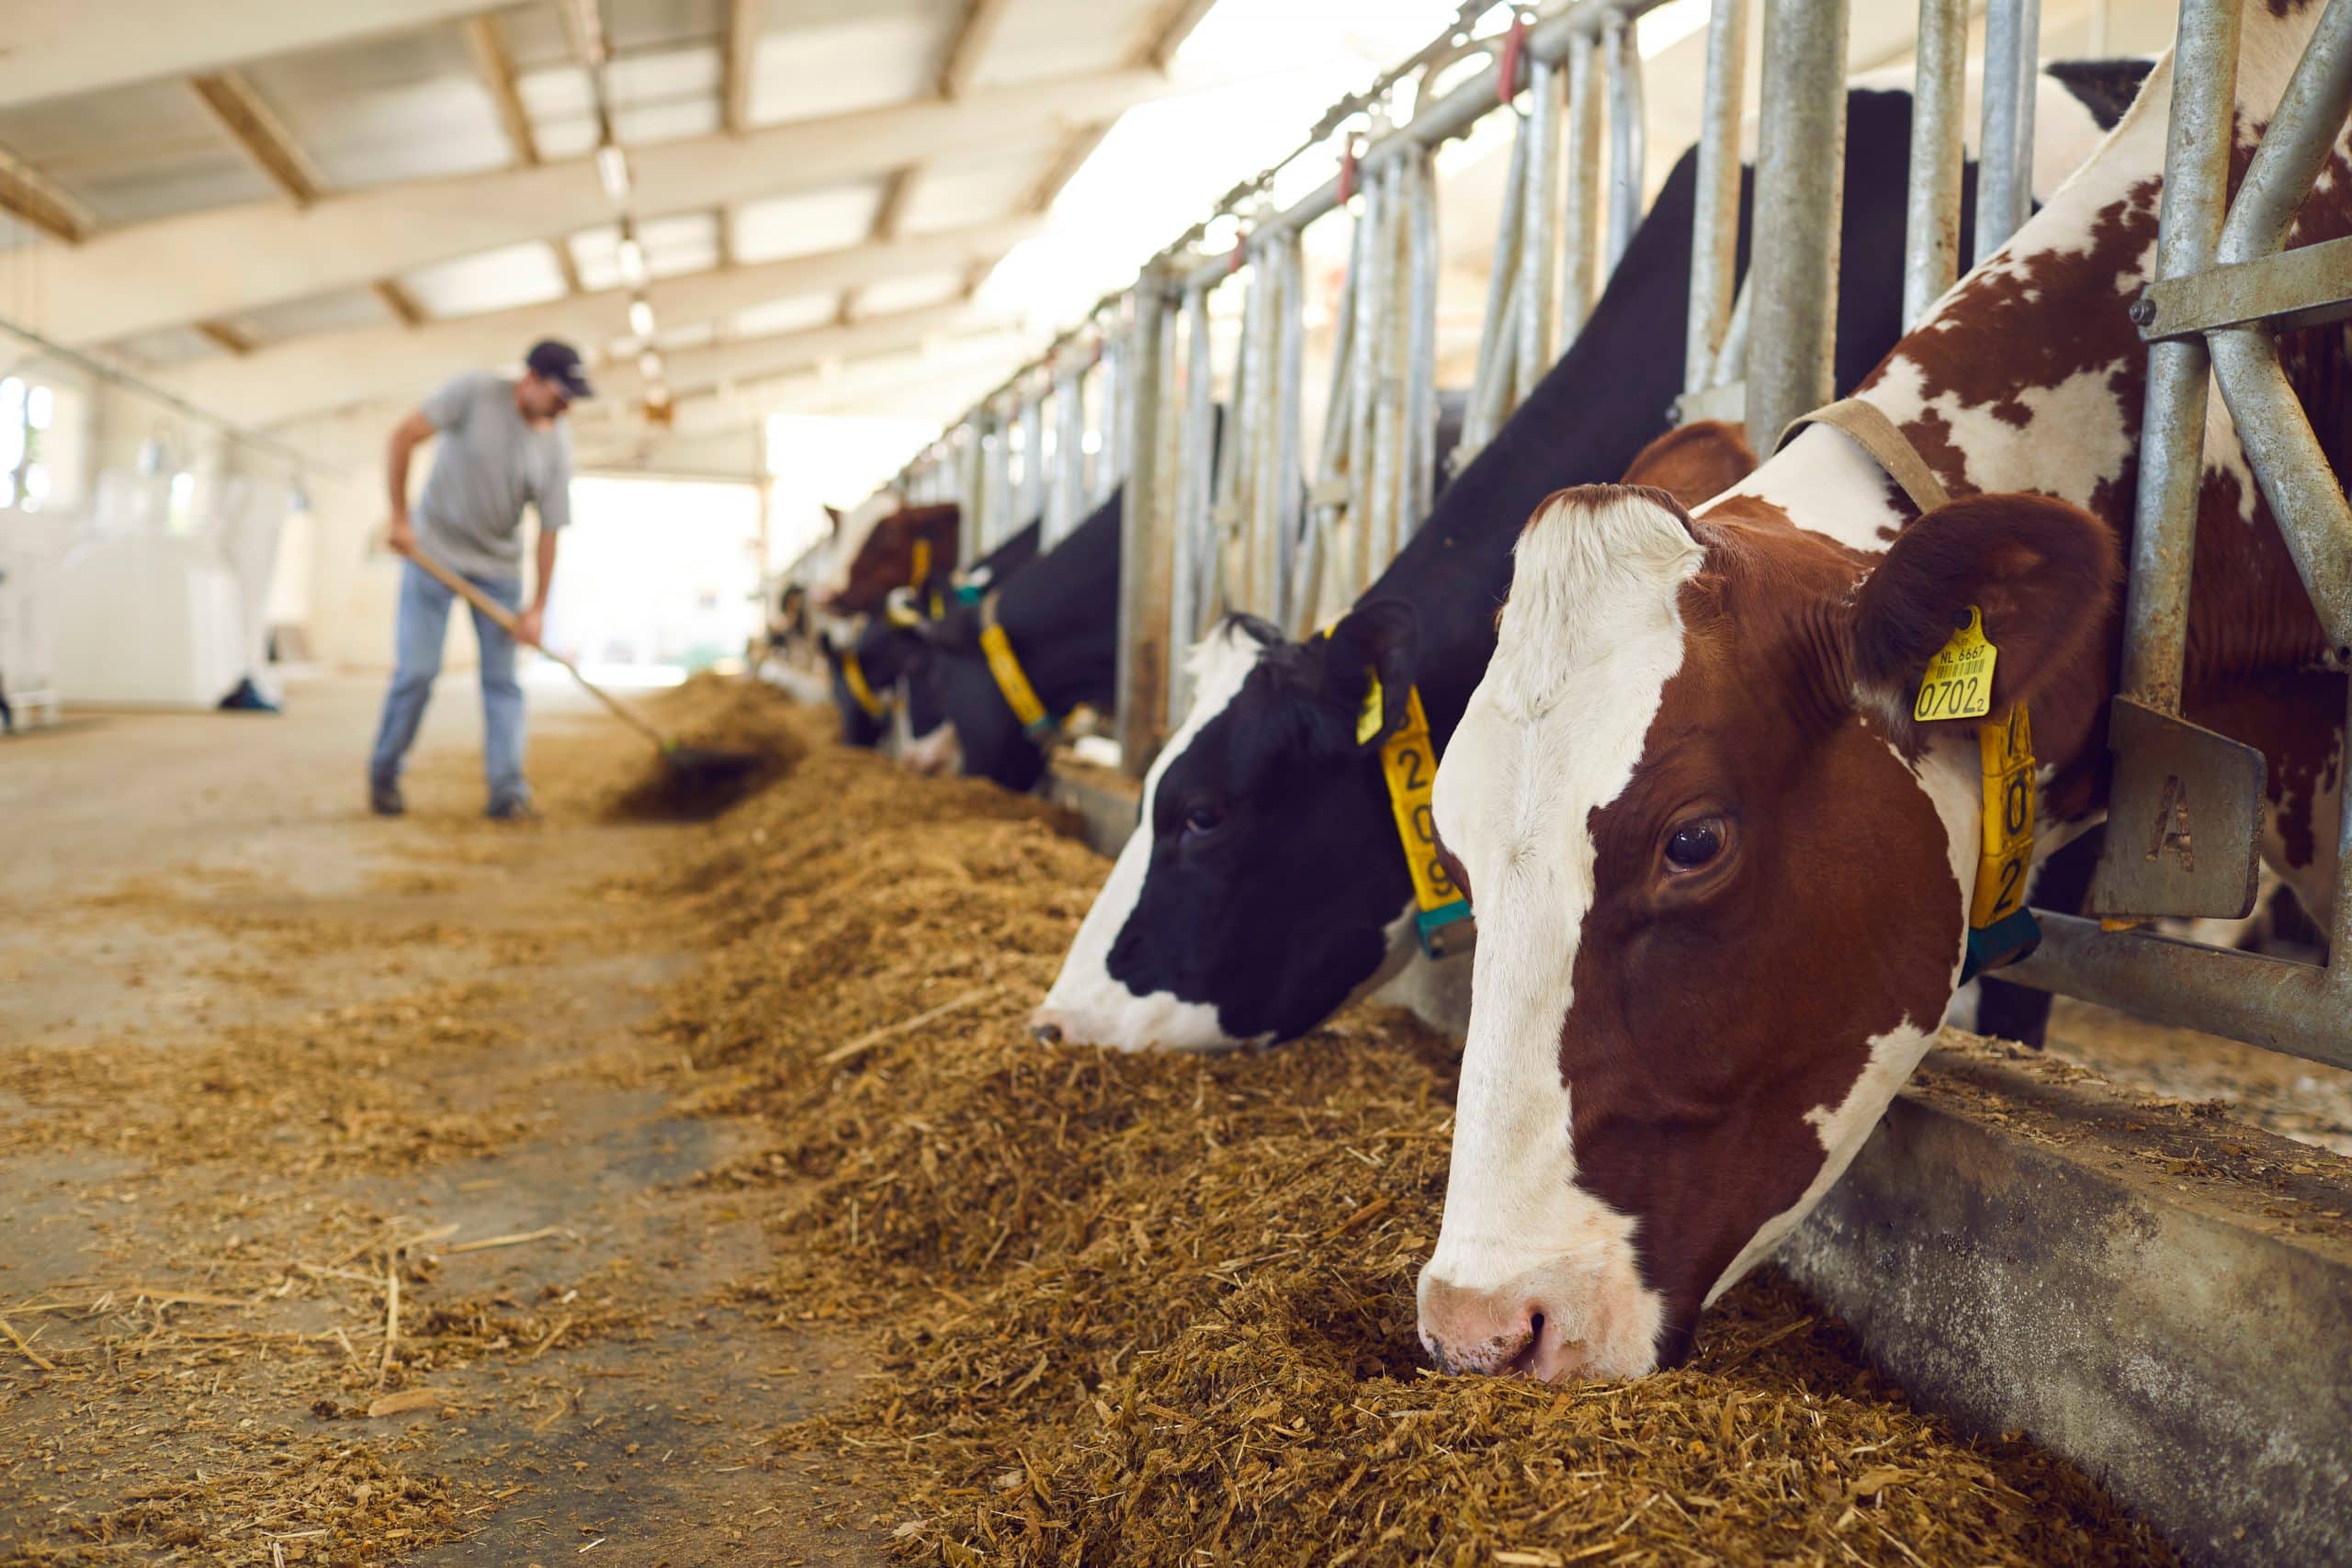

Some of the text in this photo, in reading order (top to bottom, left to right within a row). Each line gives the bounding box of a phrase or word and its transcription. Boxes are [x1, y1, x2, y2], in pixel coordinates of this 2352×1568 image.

[1940, 645, 1984, 663] NL 6667
[1917, 677, 1978, 716] 0702
[2145, 775, 2194, 872] A
